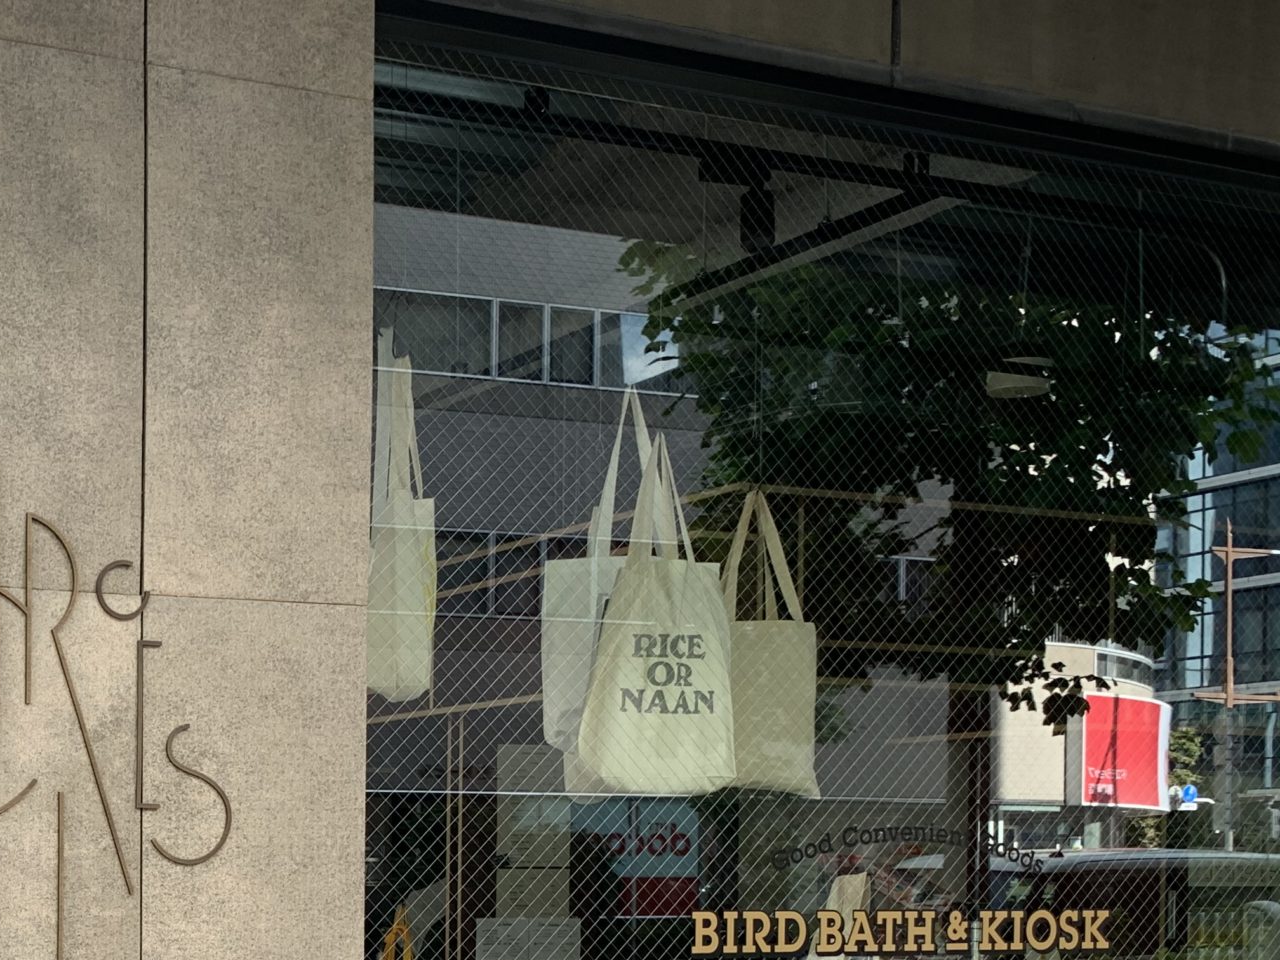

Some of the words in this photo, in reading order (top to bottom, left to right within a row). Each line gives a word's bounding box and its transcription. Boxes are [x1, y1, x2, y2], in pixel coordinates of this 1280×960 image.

[632, 633, 706, 660] RICE
[646, 661, 692, 687] OR
[620, 687, 714, 714] NAAN
[771, 834, 833, 871] Good
[691, 910, 807, 954] BIRD
[817, 910, 935, 953] BATH
[946, 910, 968, 951] &
[979, 909, 1110, 951] KIOSK
